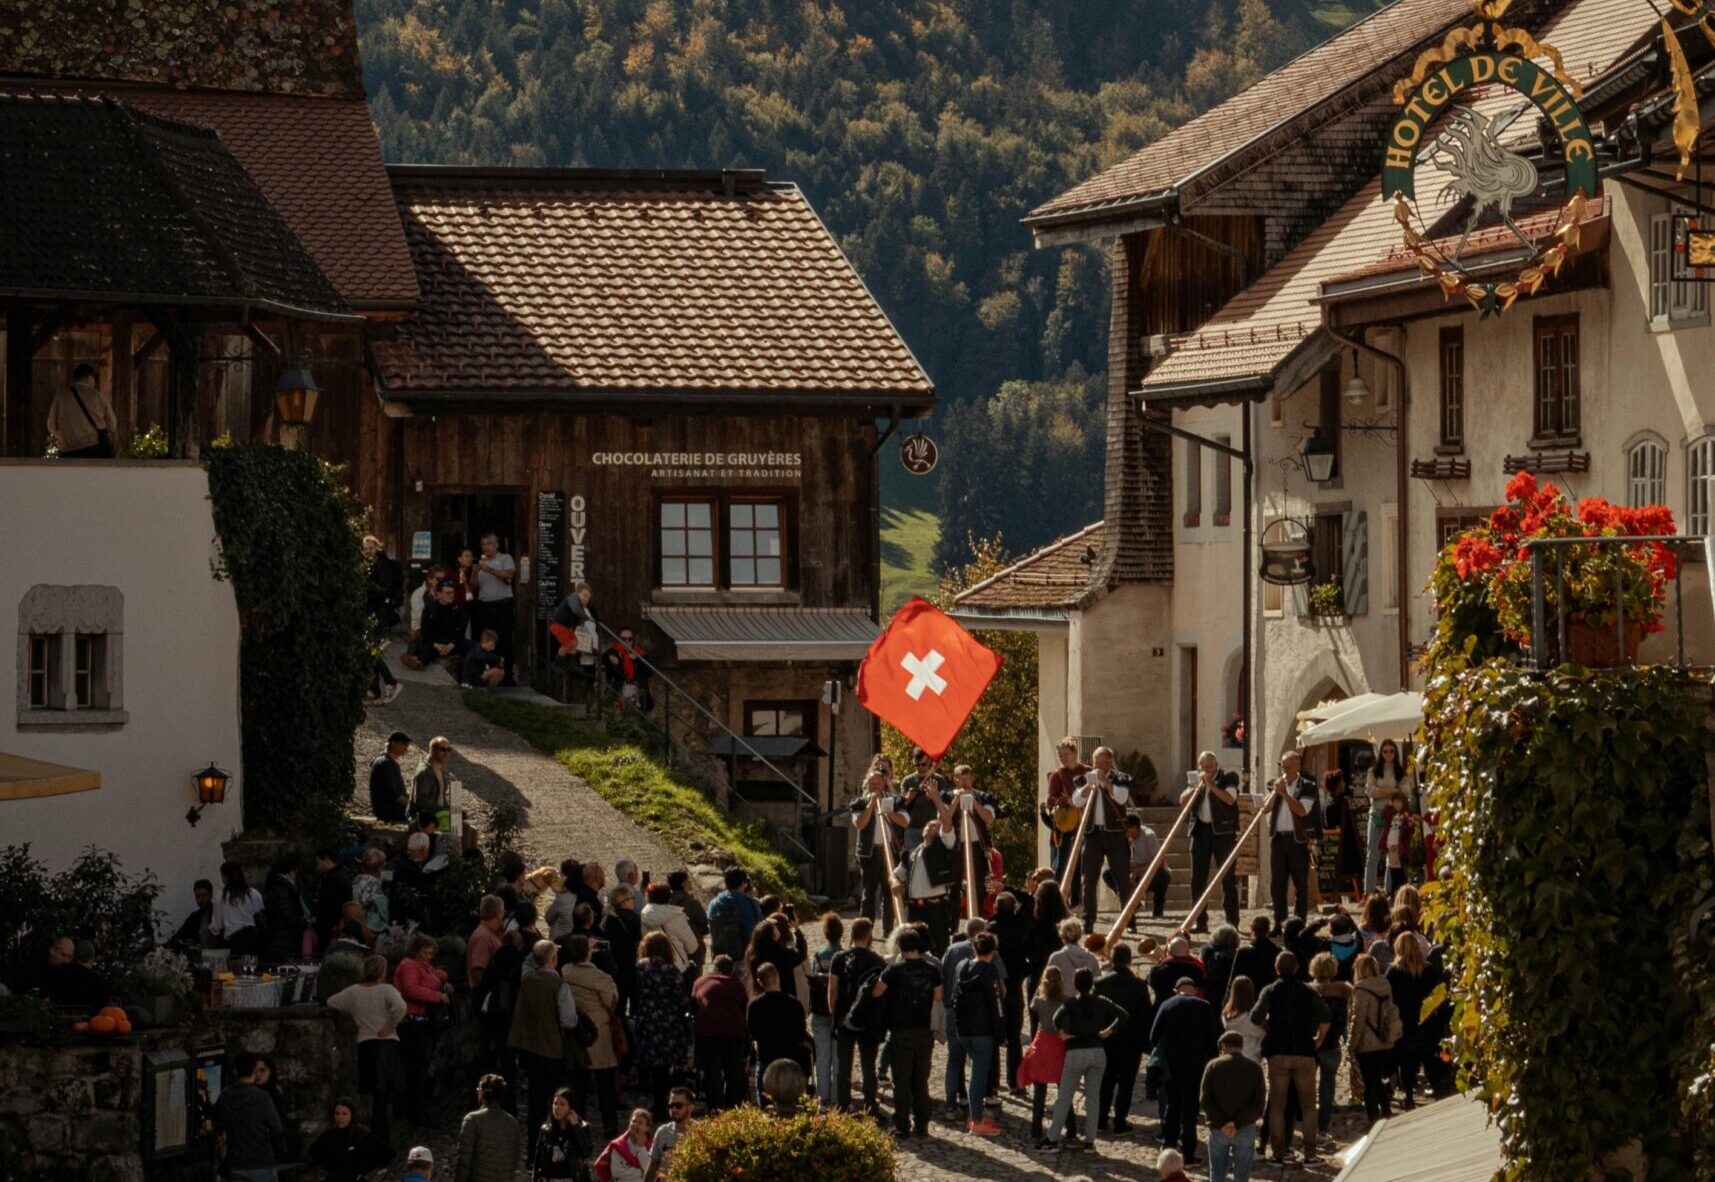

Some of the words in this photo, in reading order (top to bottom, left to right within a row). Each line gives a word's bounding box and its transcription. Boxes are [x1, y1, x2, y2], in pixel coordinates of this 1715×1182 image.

[1385, 68, 1464, 169] HOTEL
[1469, 55, 1523, 84] DE
[1531, 72, 1594, 163] VILLE
[592, 452, 701, 465] CHOCOLATERIE
[705, 453, 723, 465] DE
[728, 450, 802, 465] GRUYÈRES
[651, 469, 715, 478] ARTISANAT
[720, 469, 733, 478] ET
[739, 469, 802, 478] TRADITION
[570, 495, 586, 592] OUVERT
